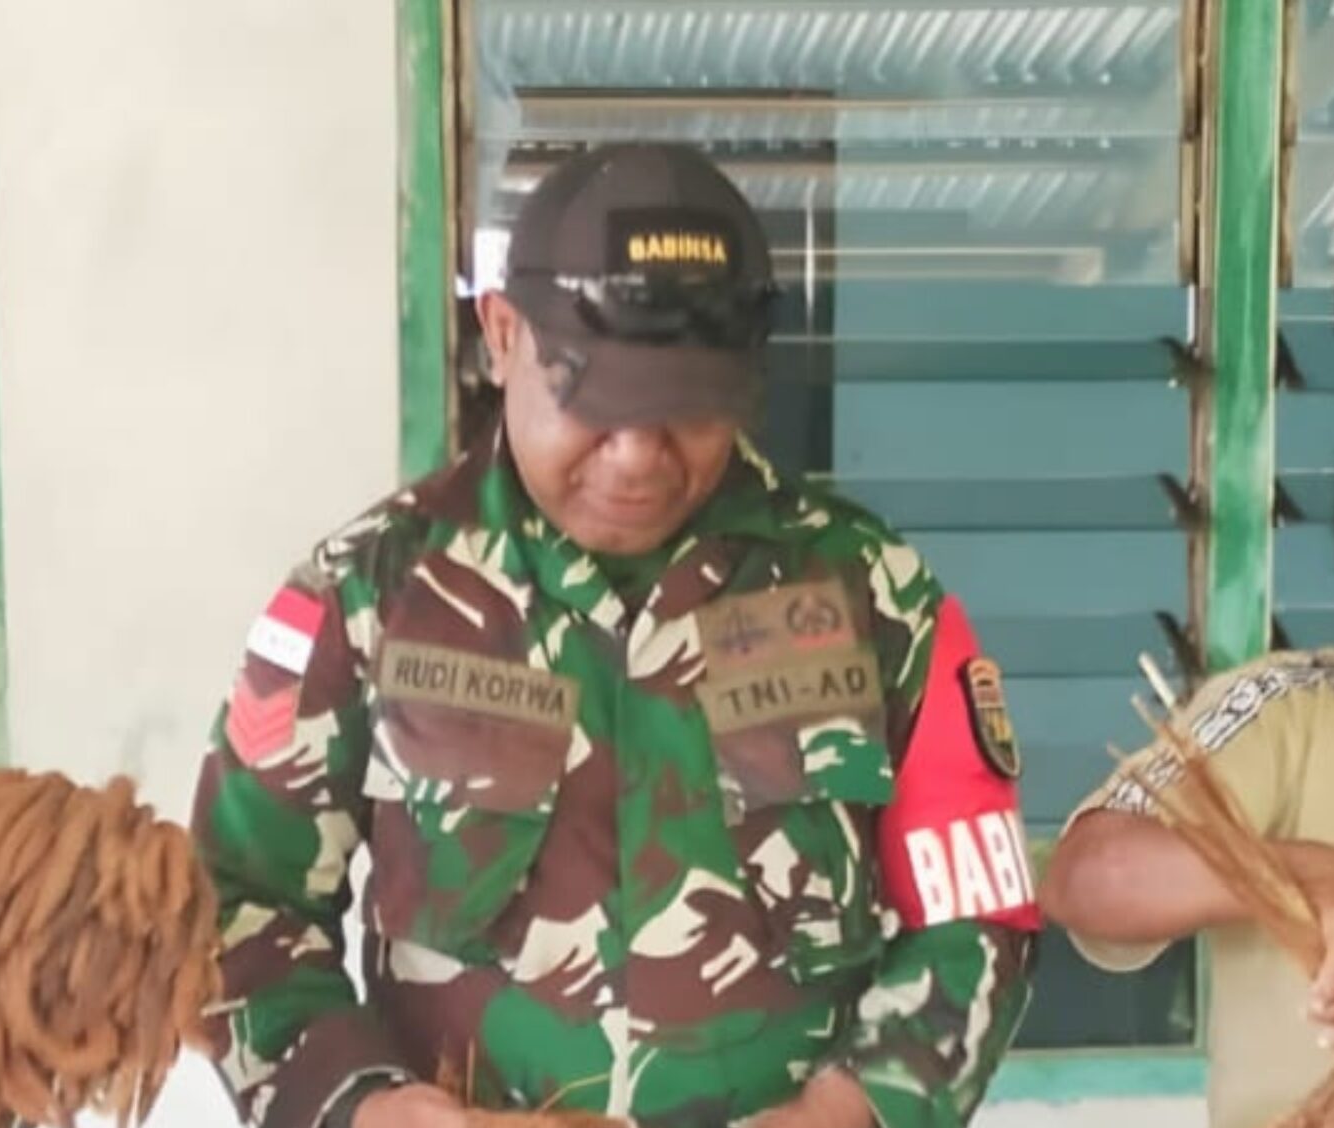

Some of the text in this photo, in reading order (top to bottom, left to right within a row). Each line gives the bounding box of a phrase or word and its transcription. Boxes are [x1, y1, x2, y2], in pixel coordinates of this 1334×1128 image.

[628, 233, 728, 263] BABINSA
[394, 654, 566, 715] RUDI KORWA
[721, 666, 867, 716] TNI-AD
